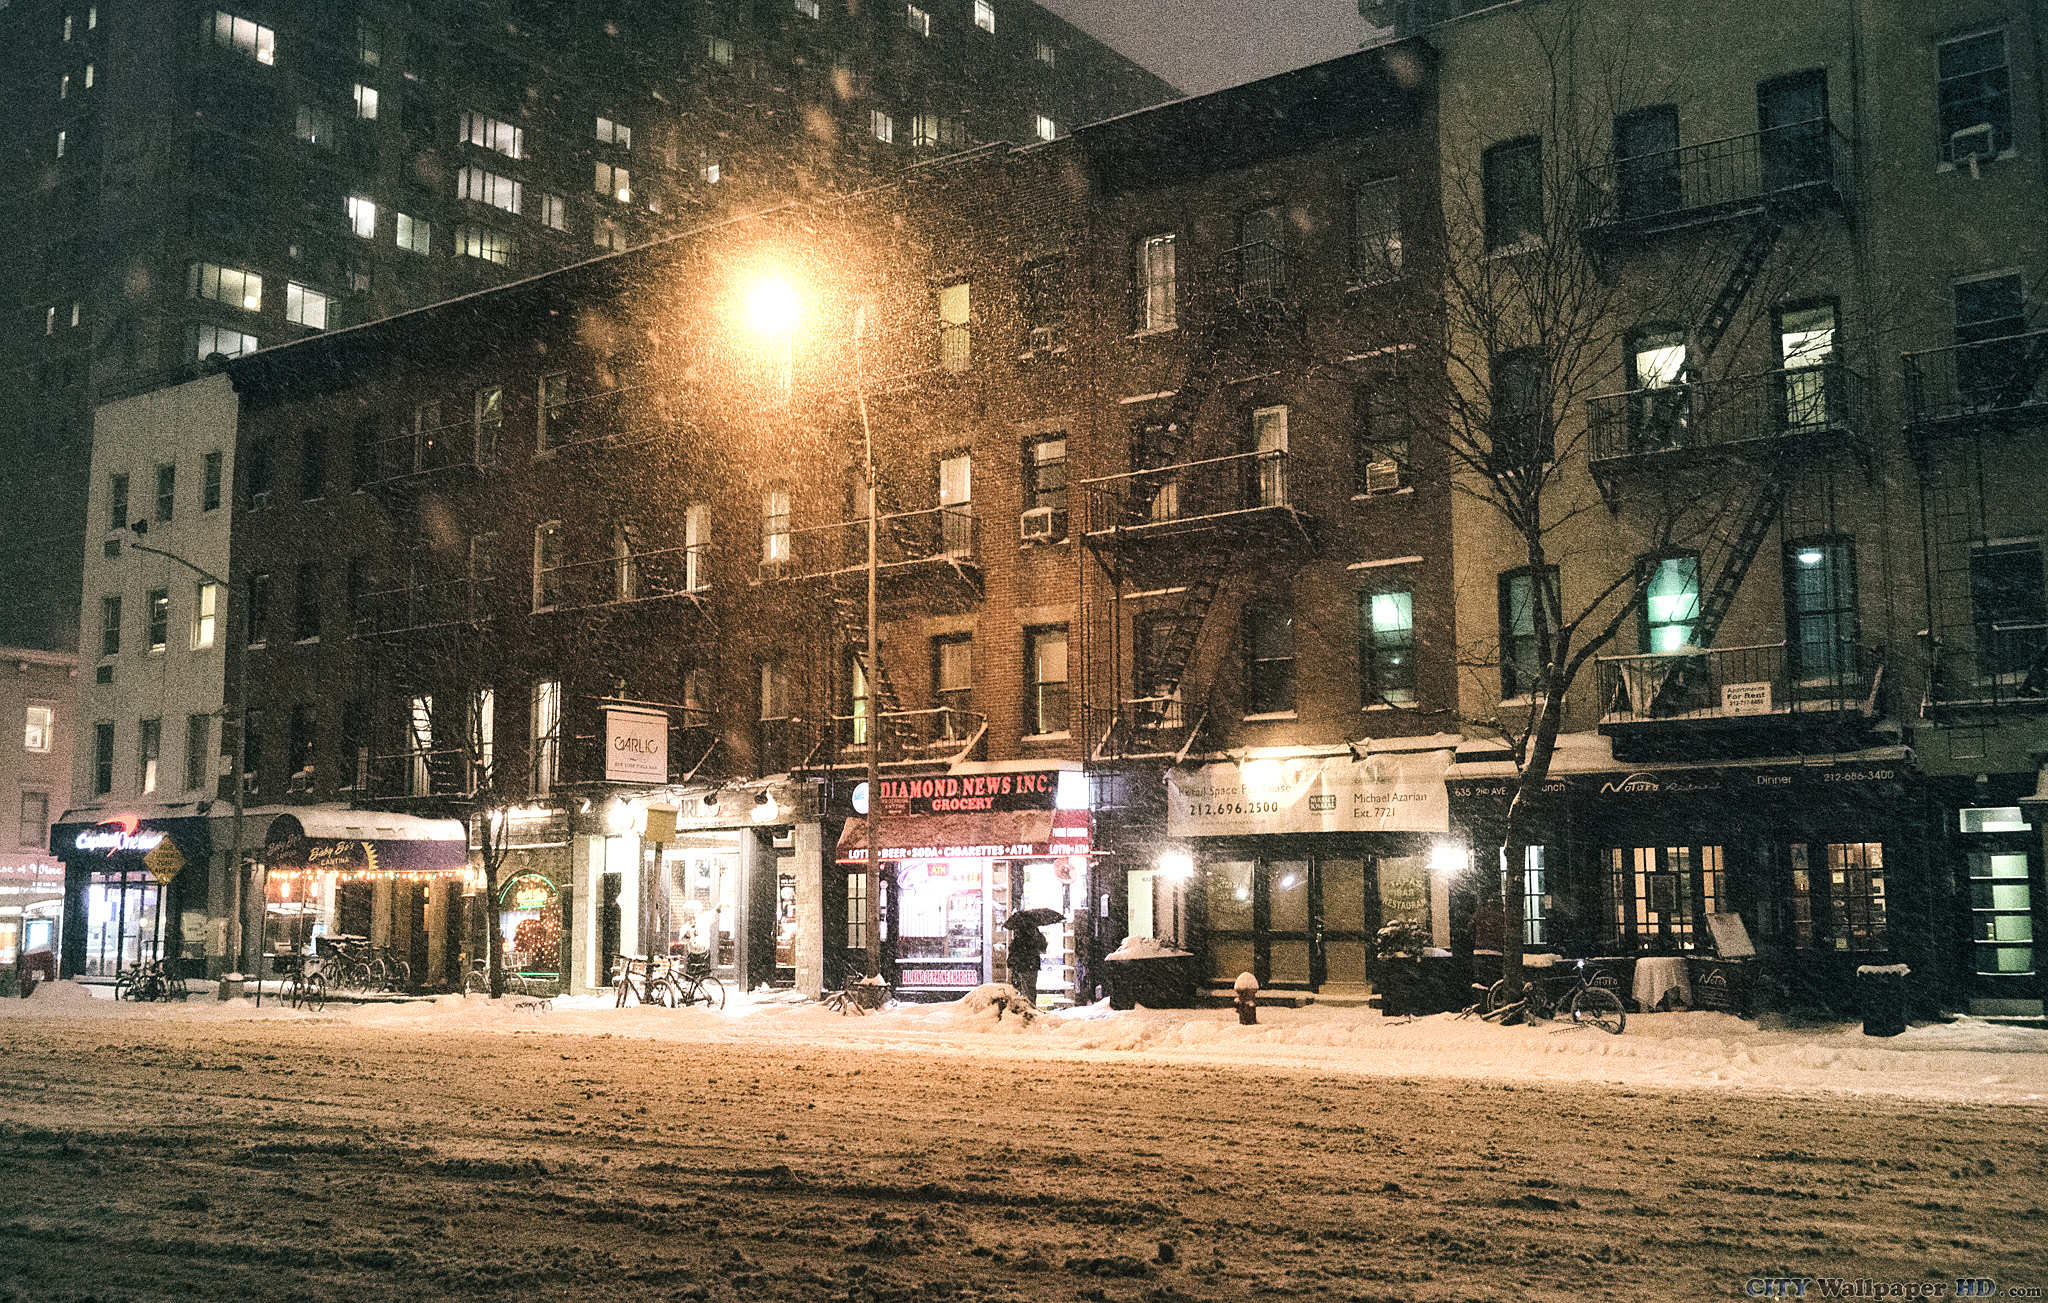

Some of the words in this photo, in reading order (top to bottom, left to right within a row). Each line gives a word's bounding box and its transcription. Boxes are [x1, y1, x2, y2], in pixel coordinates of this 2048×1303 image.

[614, 736, 659, 754] GARLIC
[880, 778, 958, 798] DIAMOND
[962, 776, 1011, 796] NEWS
[1016, 774, 1053, 794] INC.
[1757, 775, 1792, 785] Dinner
[1209, 785, 1238, 798] Space
[1455, 787, 1472, 797] 635
[1490, 786, 1508, 796] AVE
[1541, 782, 1566, 793] unch
[932, 797, 994, 811] GROCERY
[1353, 793, 1390, 803] Michael
[1392, 792, 1427, 802] Azarian
[1190, 801, 1278, 816] 212.696.2500
[1353, 808, 1372, 818] Ext.
[1374, 807, 1395, 817] 7721
[308, 845, 334, 861] Baby
[848, 849, 869, 859] LOTT
[881, 848, 907, 858] BEER
[911, 847, 938, 857] SODA
[944, 845, 1004, 857] CIGARETTES
[1010, 844, 1033, 855] ATM
[1382, 897, 1427, 910] RESTAURAN
